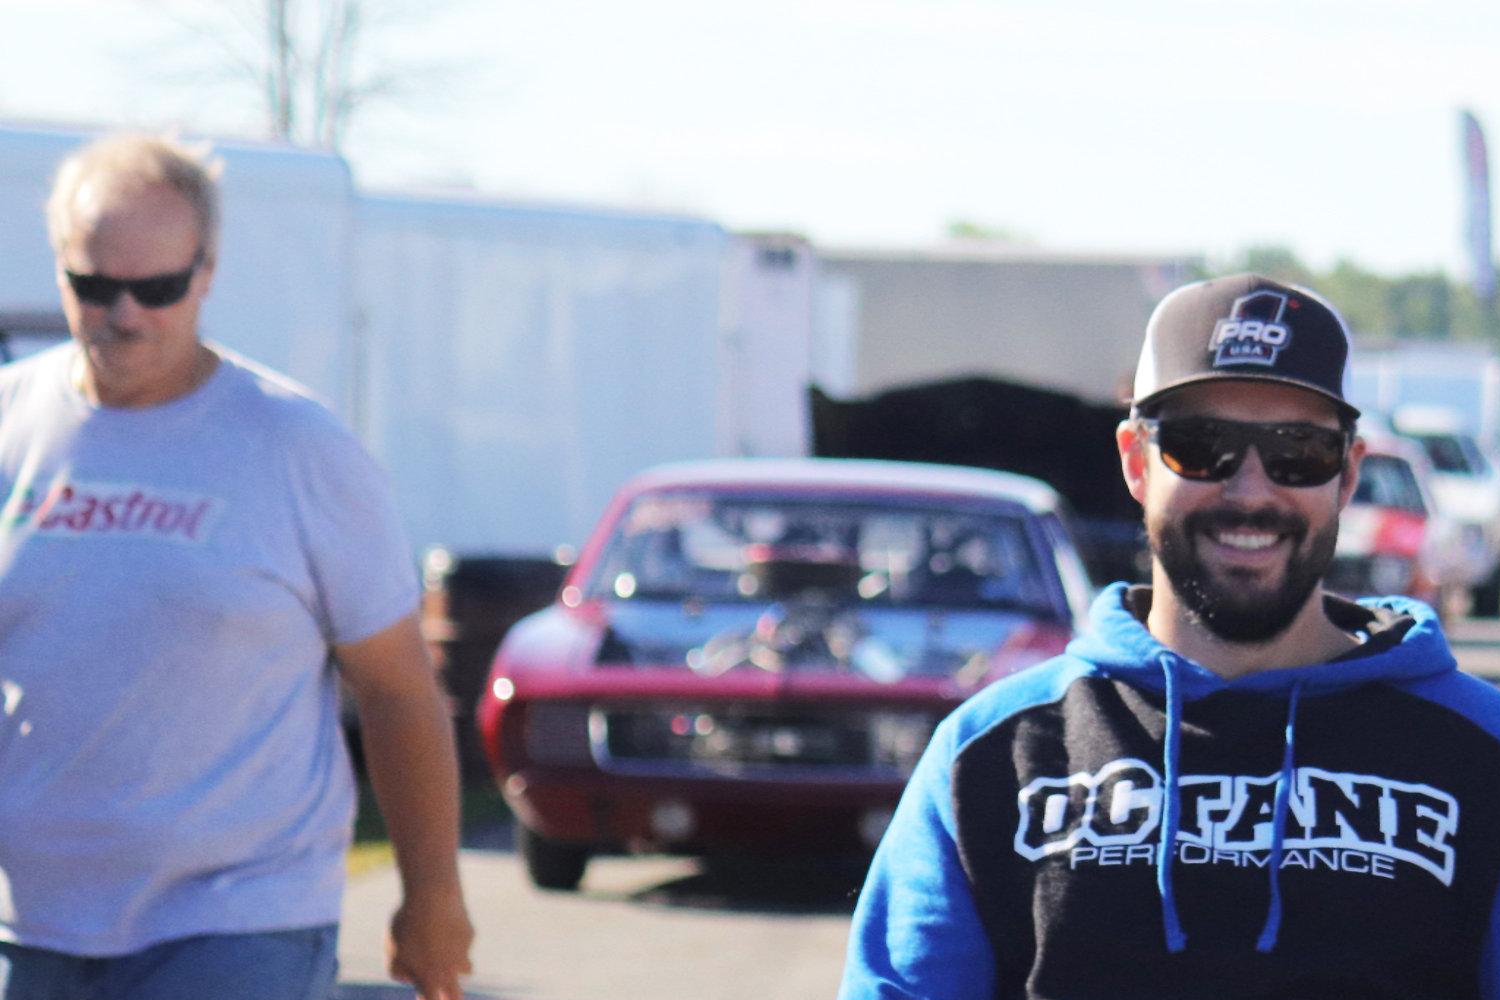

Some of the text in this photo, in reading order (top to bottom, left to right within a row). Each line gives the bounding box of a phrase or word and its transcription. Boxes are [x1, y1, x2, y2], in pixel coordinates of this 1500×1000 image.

[1216, 320, 1288, 346] PRO
[38, 484, 210, 540] Castrol
[1013, 757, 1459, 887] OCTANE
